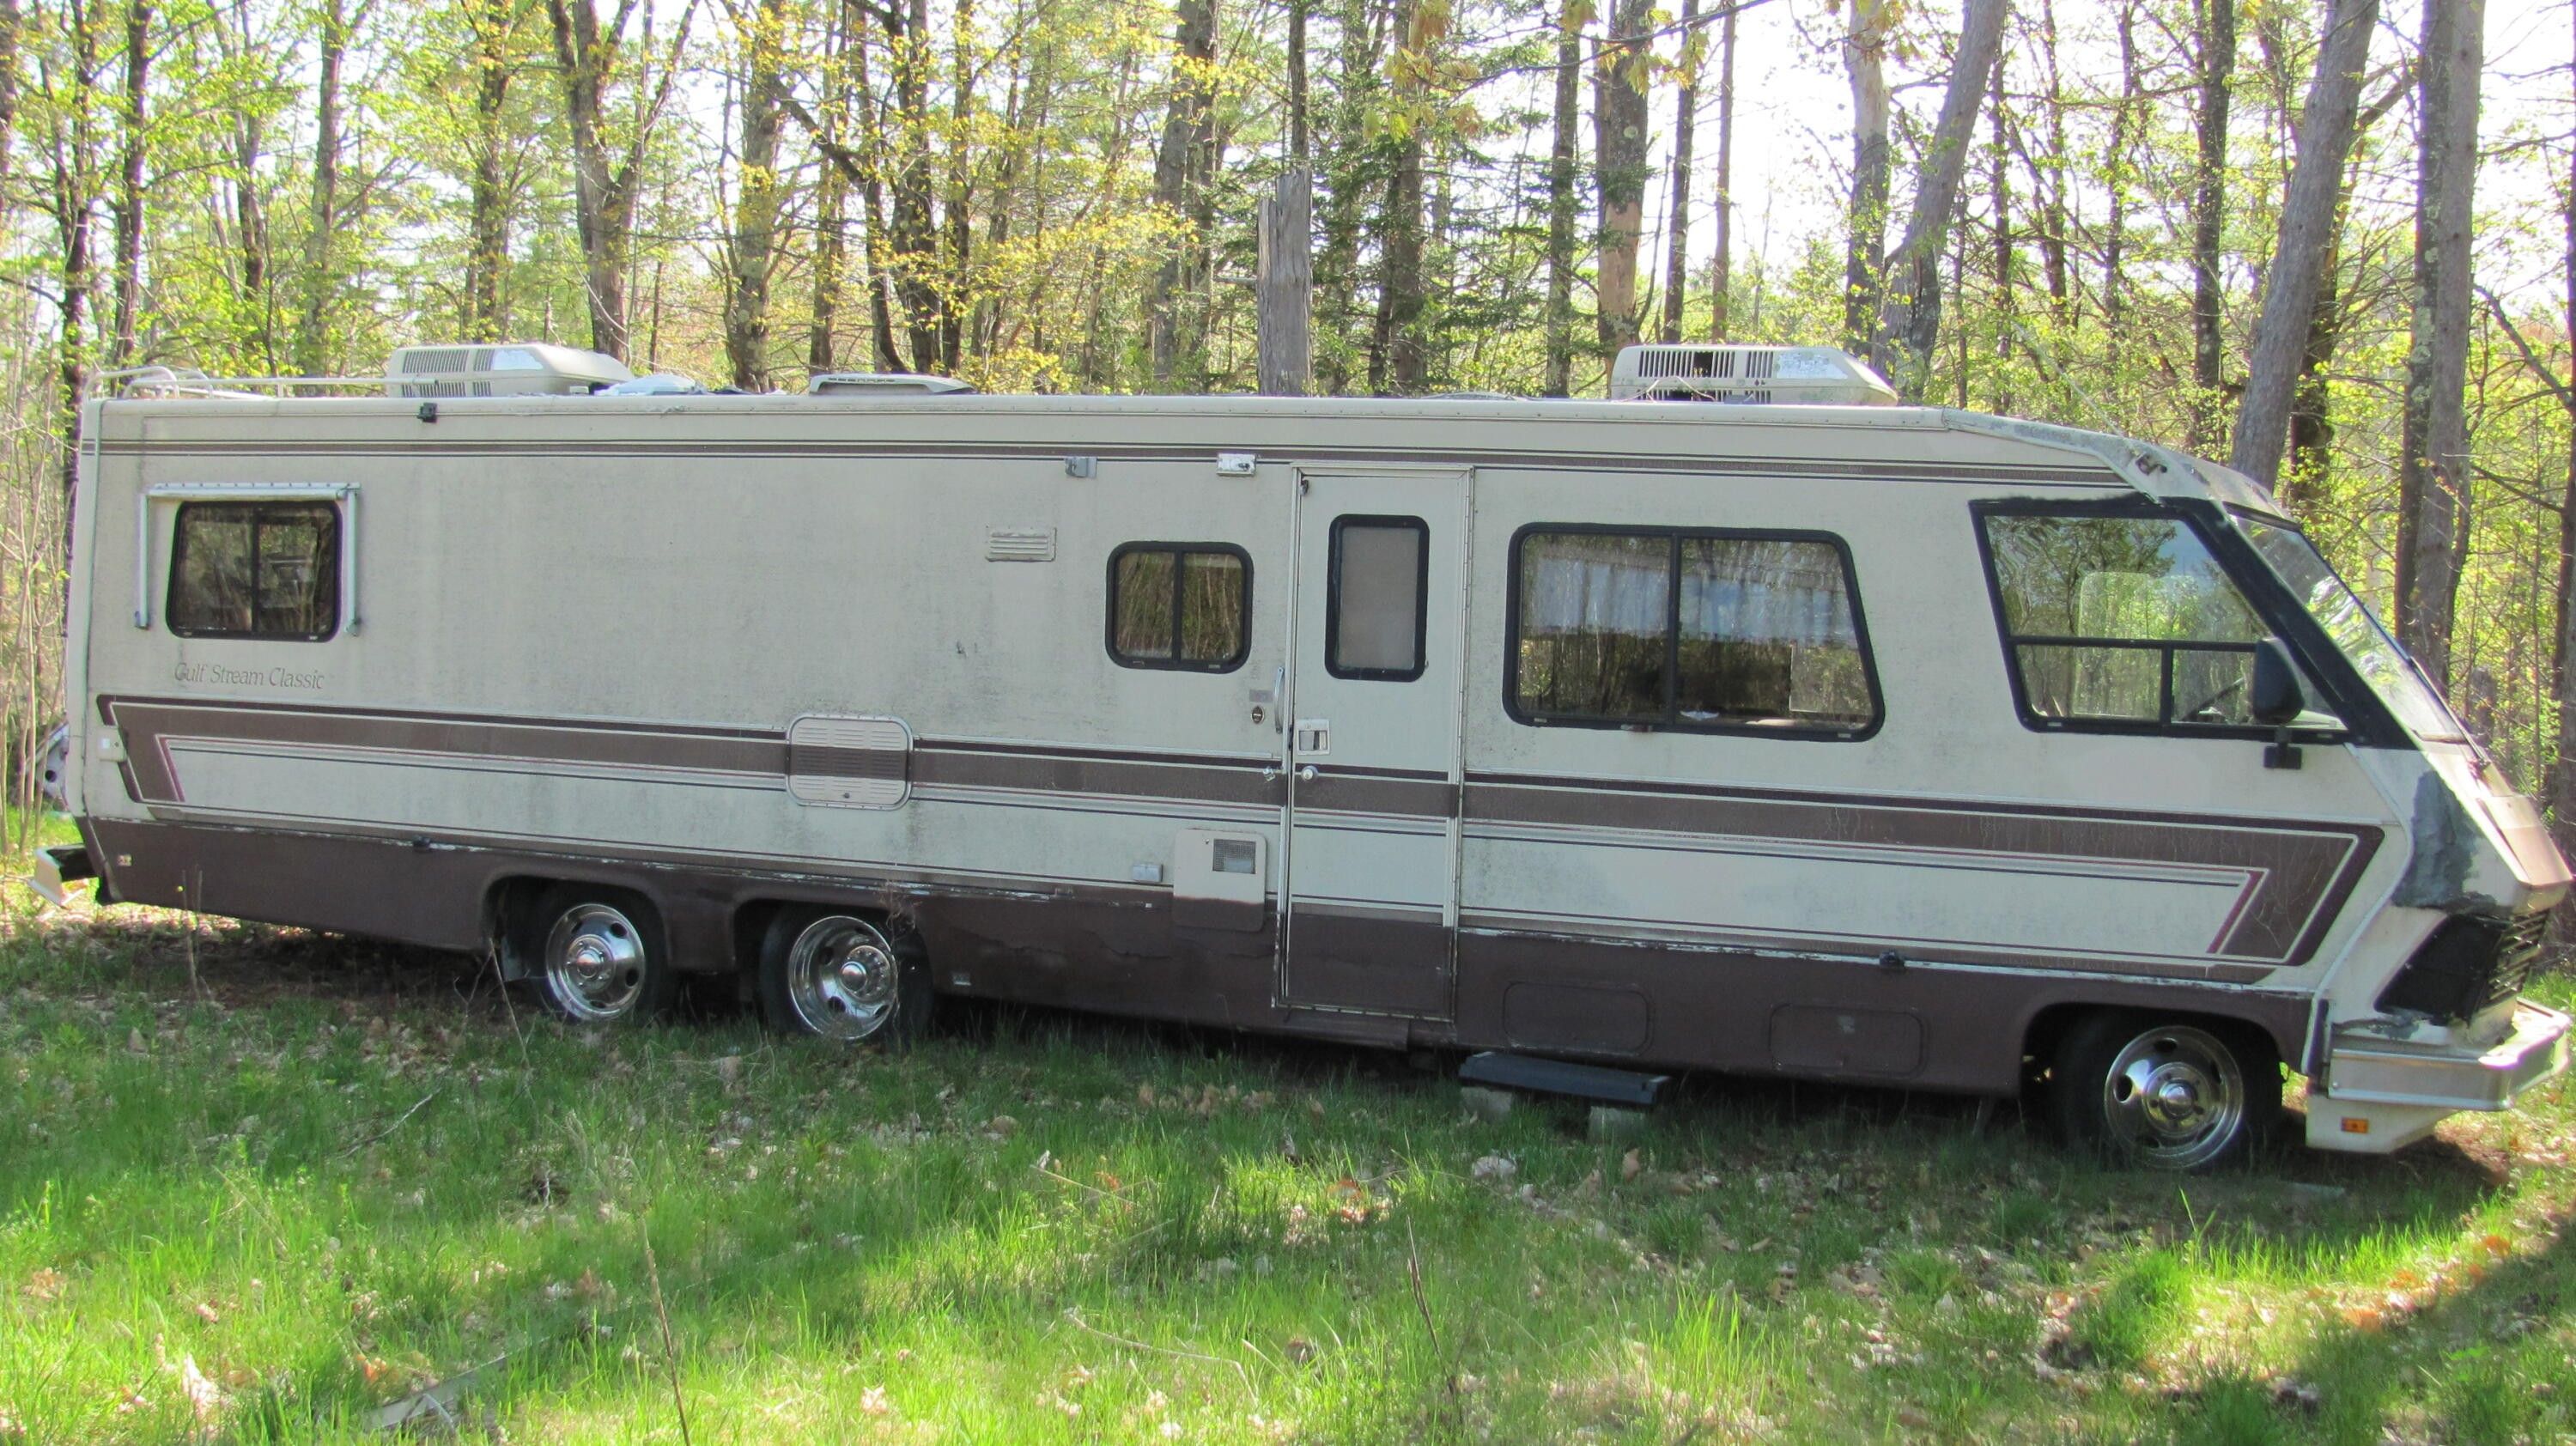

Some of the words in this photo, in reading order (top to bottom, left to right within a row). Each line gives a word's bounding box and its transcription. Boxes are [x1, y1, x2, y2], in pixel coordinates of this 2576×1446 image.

[174, 662, 207, 683] Gulf
[210, 665, 264, 686] Stream
[269, 667, 325, 689] Classic
